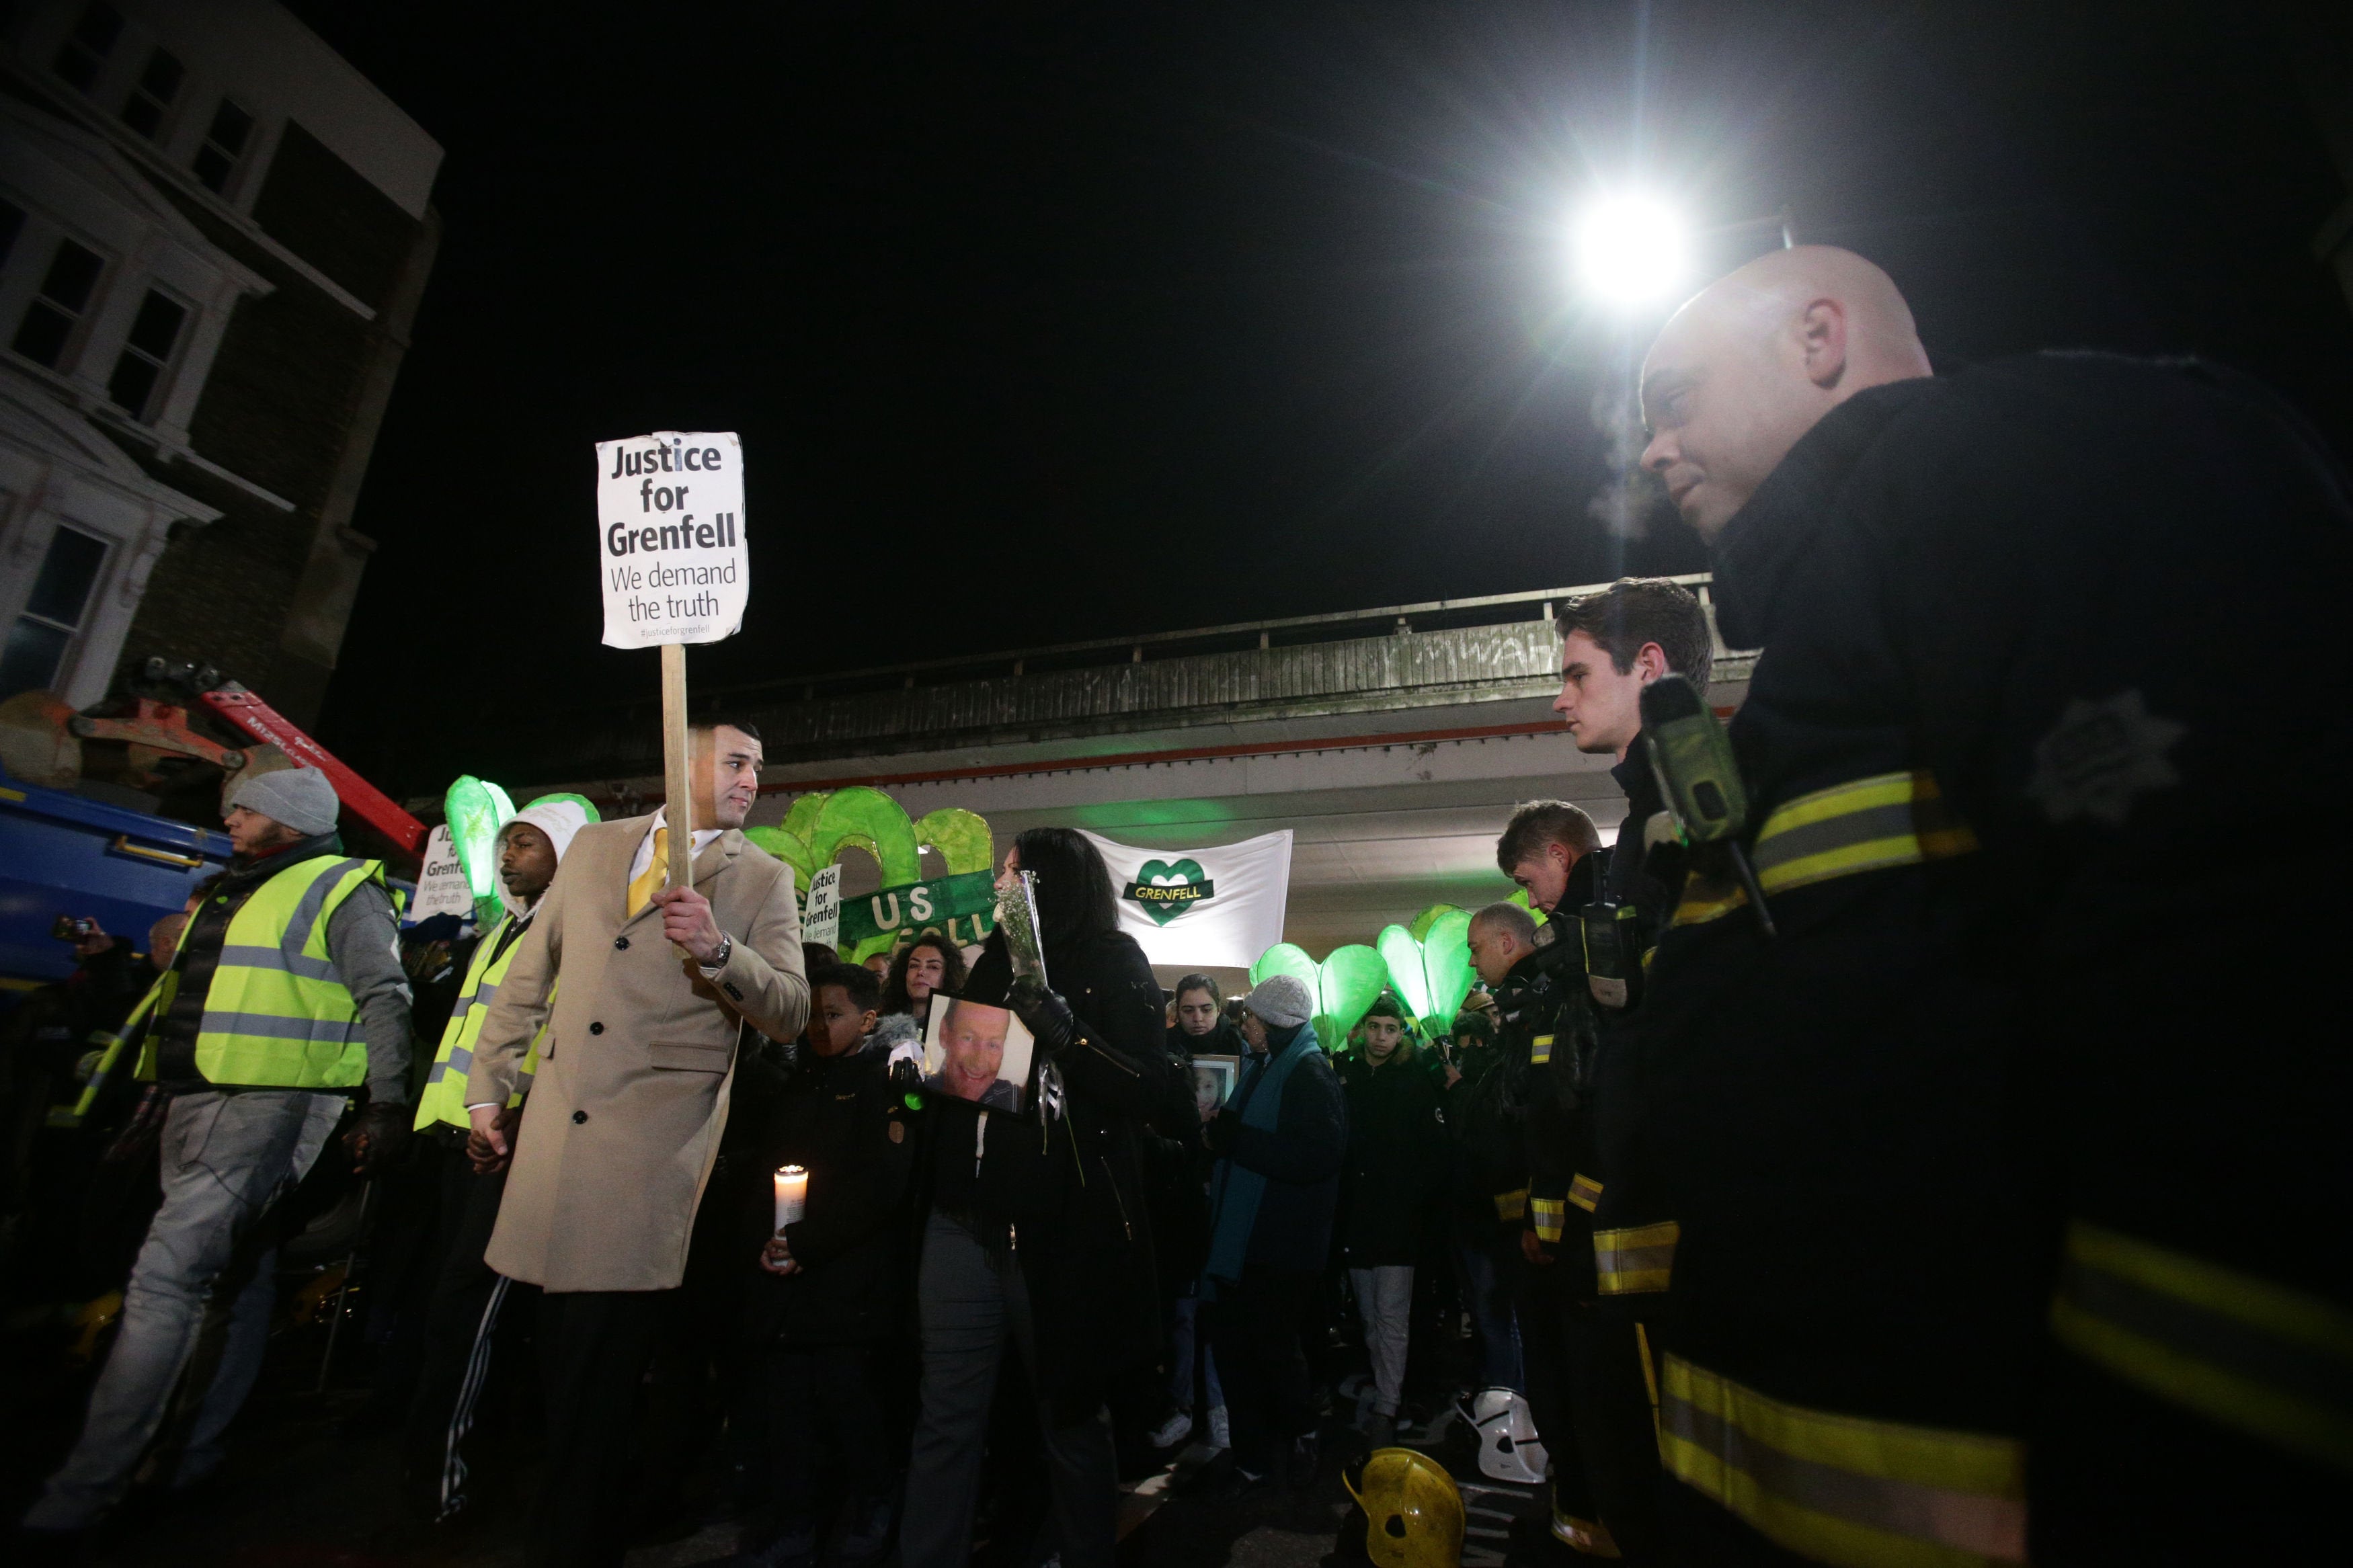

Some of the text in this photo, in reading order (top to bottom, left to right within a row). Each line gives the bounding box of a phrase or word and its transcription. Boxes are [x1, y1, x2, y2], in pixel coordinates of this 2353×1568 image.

[611, 438, 721, 479] Justice
[640, 479, 689, 513] for
[608, 512, 736, 556] Grenfell
[610, 558, 736, 592] We demand
[628, 590, 719, 622] the truth
[641, 624, 710, 638] #justiceforgrenfell
[815, 892, 827, 906] for
[1135, 886, 1201, 900] GRENFELL
